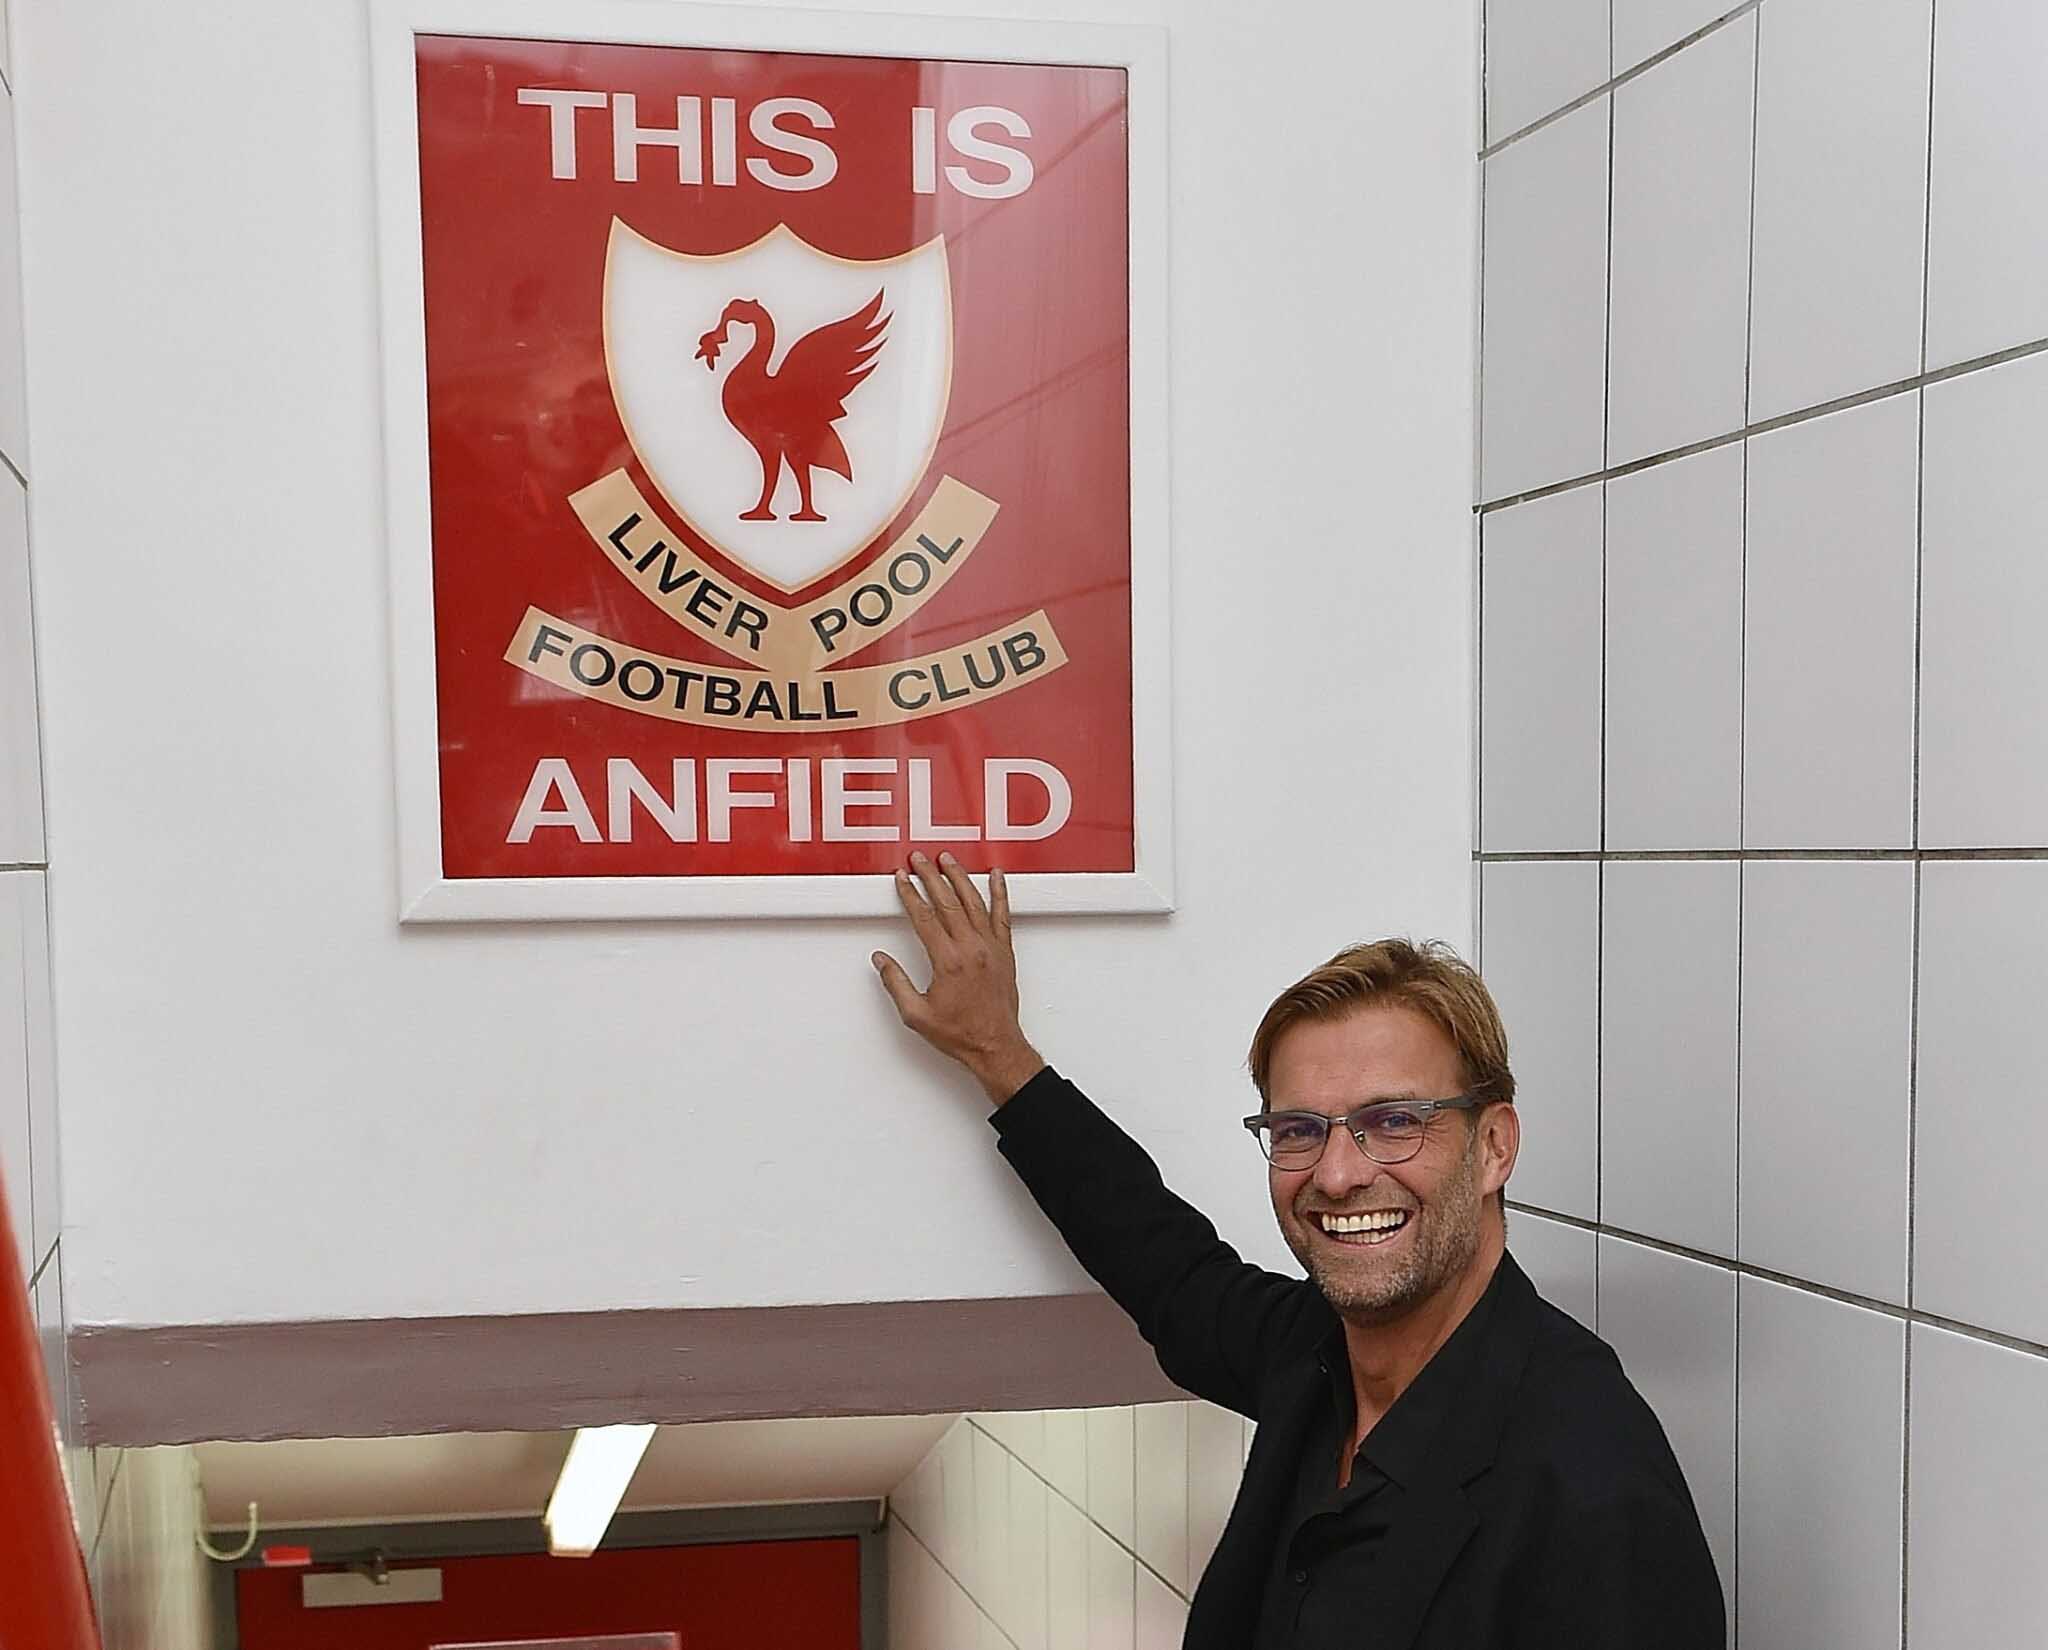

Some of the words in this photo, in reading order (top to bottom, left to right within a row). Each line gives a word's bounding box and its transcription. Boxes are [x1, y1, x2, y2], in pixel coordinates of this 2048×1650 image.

[517, 87, 839, 192] THIS
[912, 105, 1035, 200] IS
[607, 512, 769, 651] LIVER
[810, 532, 965, 652] POOL
[528, 624, 858, 721] FOOTBALL
[888, 630, 1046, 710] CLUB
[505, 757, 1073, 843] ANFIELD
